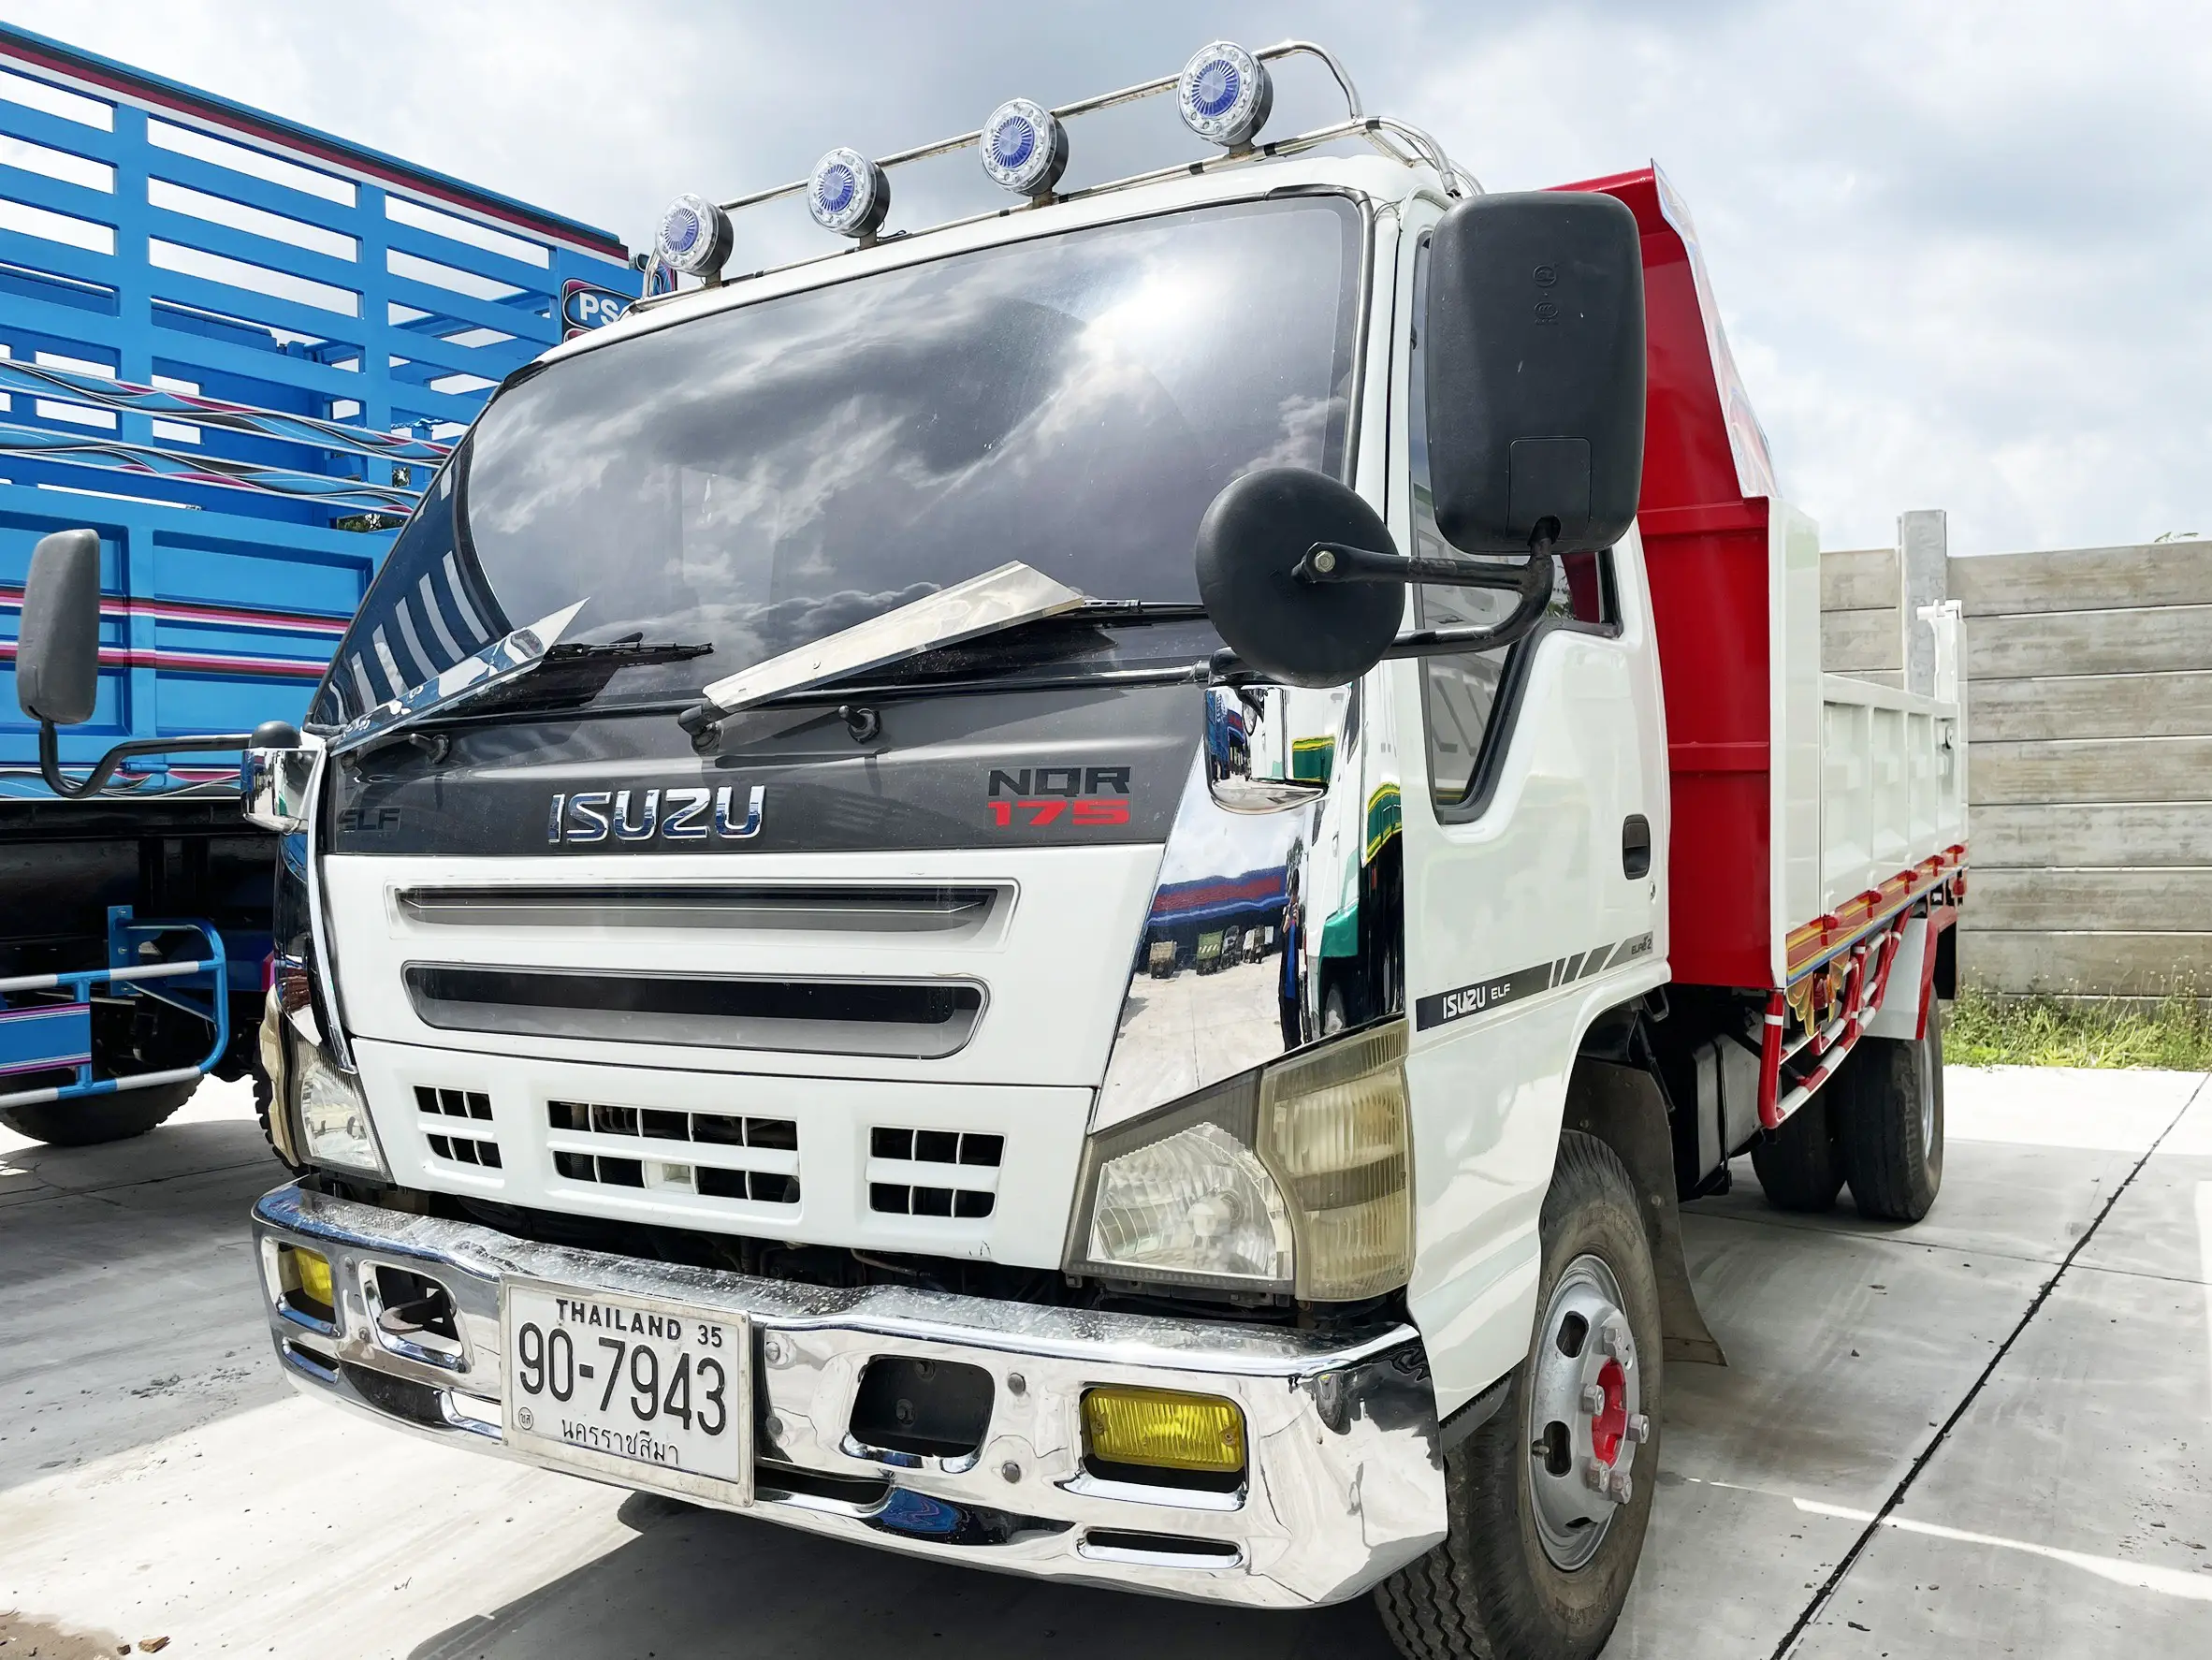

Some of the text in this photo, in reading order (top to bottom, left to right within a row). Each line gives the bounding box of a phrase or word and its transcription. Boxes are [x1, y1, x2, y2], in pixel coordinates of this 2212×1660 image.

[579, 292, 629, 327] PS
[988, 766, 1131, 797] NQR
[339, 808, 401, 832] ELF
[548, 785, 766, 845] ISUZU
[987, 800, 1130, 826] 175
[1443, 983, 1511, 1019] ISUZU ELF
[556, 1298, 722, 1347] THAILAND 35
[518, 1321, 726, 1436] 90-7943
[561, 1419, 679, 1465] นครราชสีมา
